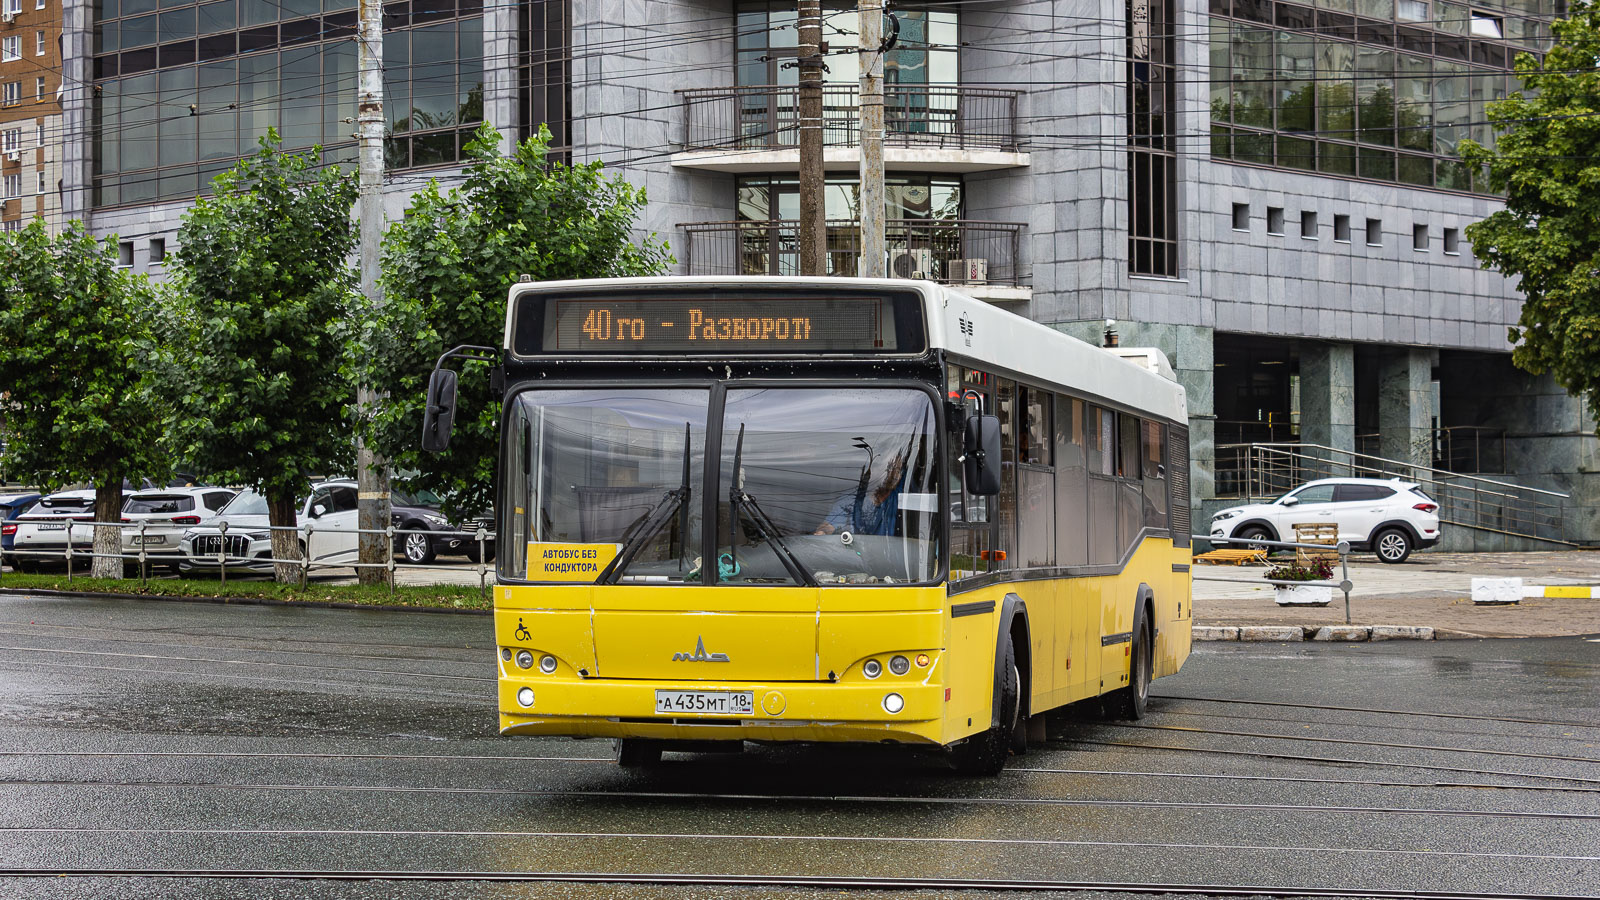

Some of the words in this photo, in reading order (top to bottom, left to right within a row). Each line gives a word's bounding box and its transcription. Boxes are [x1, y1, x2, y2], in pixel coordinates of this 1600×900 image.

[542, 549, 580, 559] АВТОБУС
[581, 549, 597, 559] БЕЗ
[544, 563, 598, 573] КОНДУКТОРА
[732, 694, 747, 707] 18
